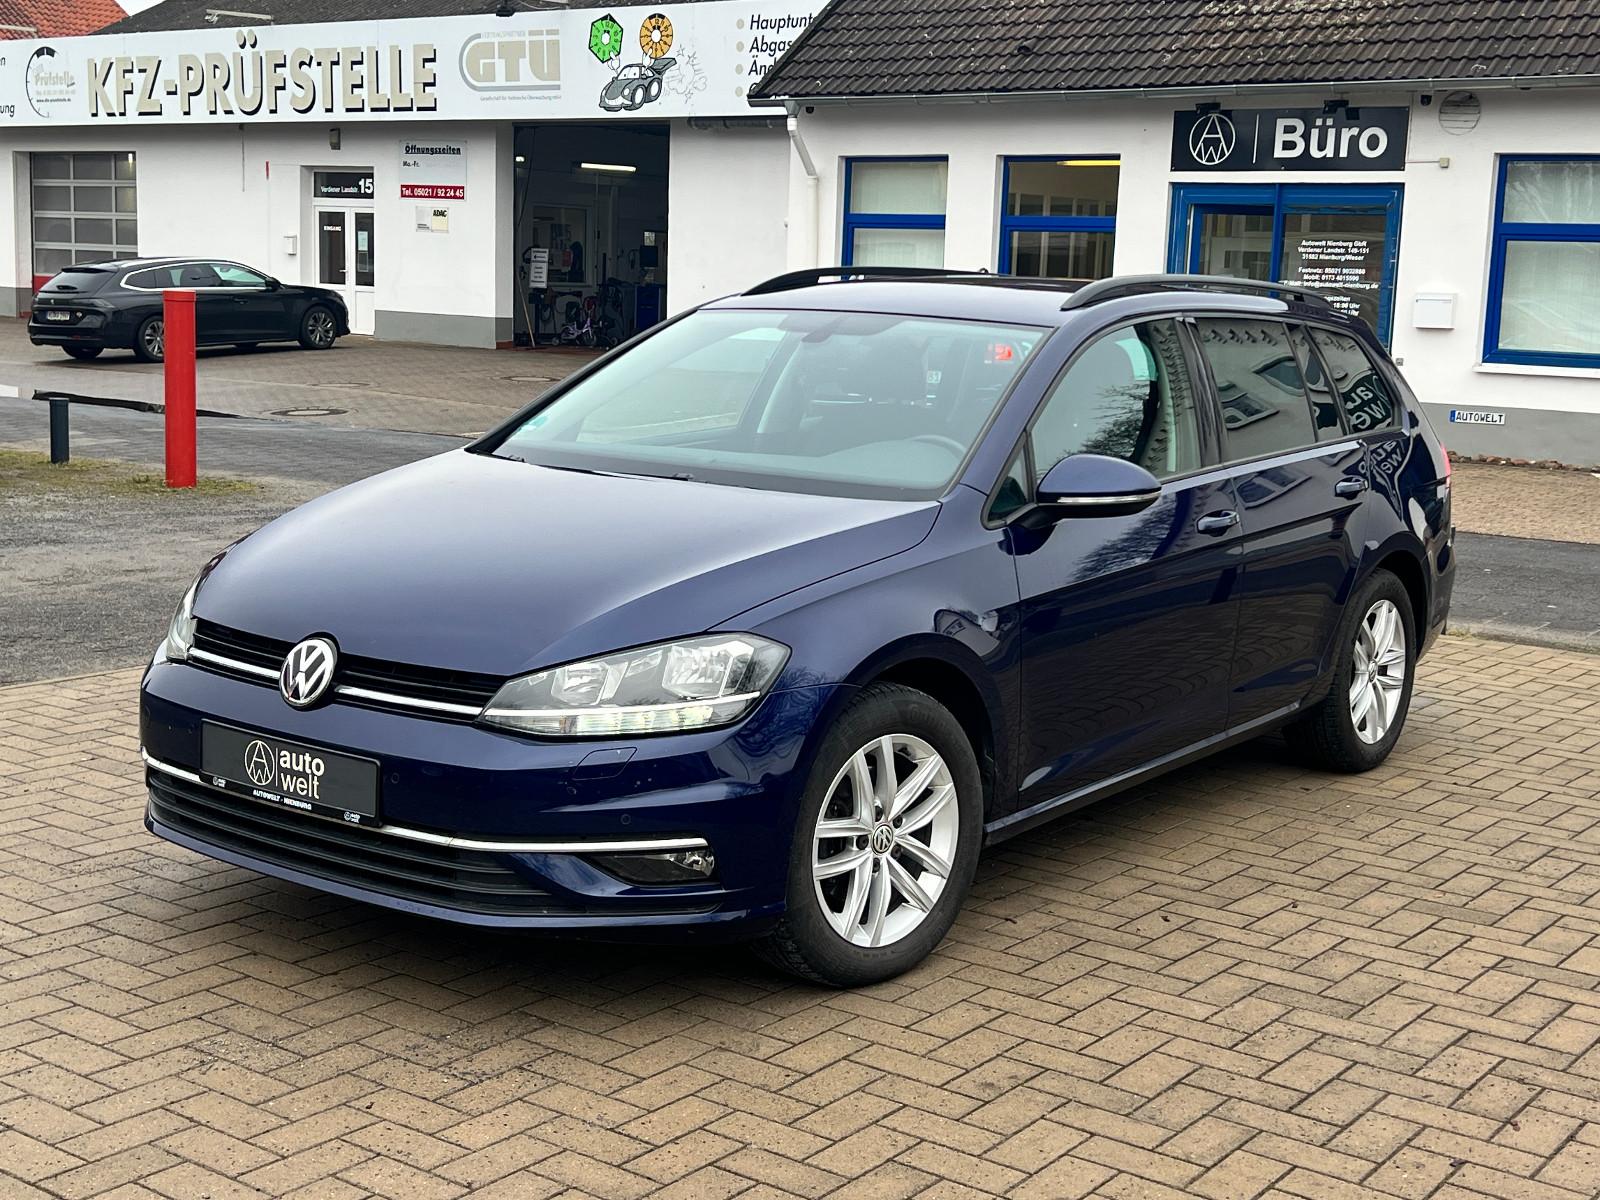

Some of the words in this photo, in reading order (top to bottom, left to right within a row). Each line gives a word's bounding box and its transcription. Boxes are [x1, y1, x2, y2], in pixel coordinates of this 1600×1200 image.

[465, 29, 561, 82] GTÜ
[87, 29, 437, 117] KFZ-PRÜFSTELLE
[405, 143, 461, 155] Öffnungszeiten
[1273, 117, 1388, 159] Büro
[402, 188, 413, 196] Tel.
[414, 188, 433, 197] 05021
[437, 189, 445, 197] 92
[446, 189, 454, 197] 24
[455, 189, 464, 198] 45
[1455, 411, 1504, 423] AUTOWELT
[279, 750, 325, 777] auto
[280, 772, 320, 799] welt
[252, 789, 281, 802] AUTOWELT
[283, 797, 312, 810] NIENBURG
